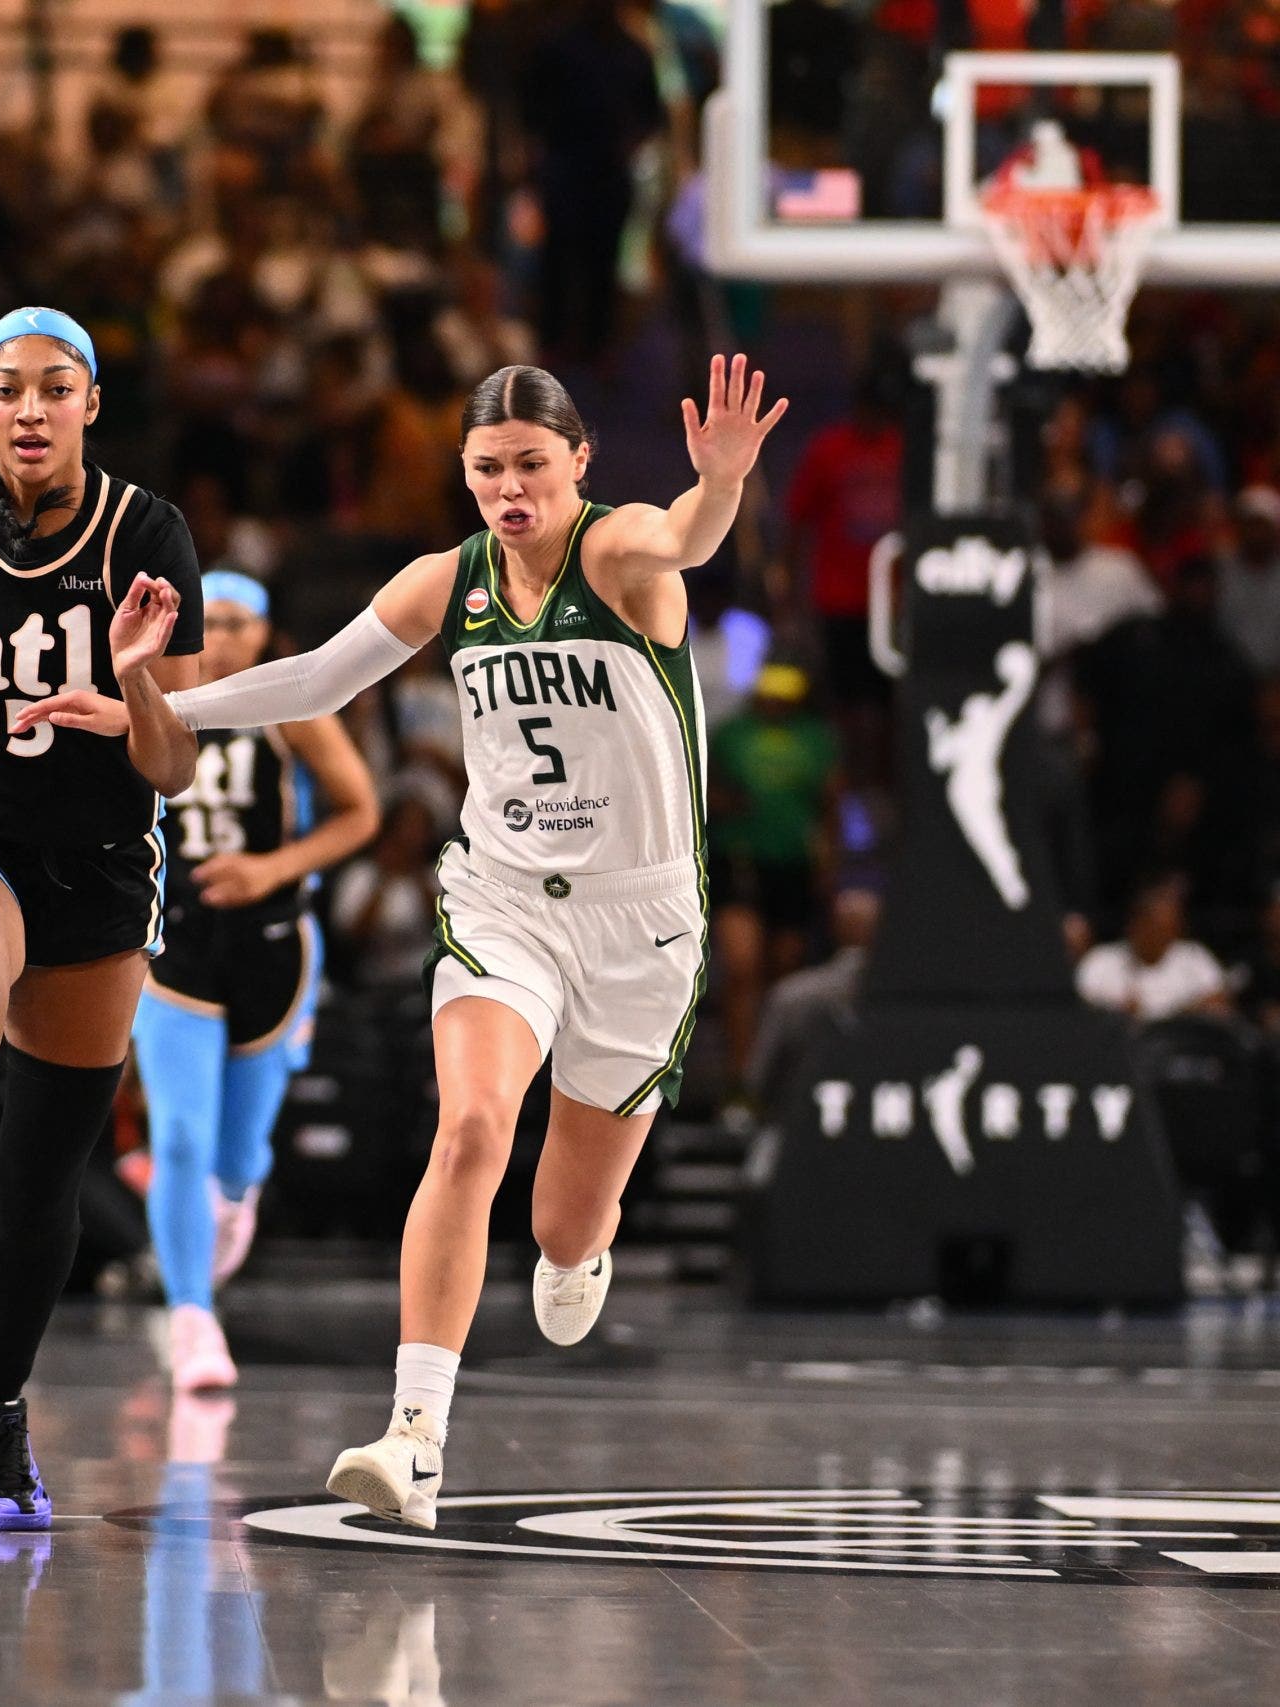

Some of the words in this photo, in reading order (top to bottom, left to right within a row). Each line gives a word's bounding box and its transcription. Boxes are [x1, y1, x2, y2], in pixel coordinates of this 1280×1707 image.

[58, 575, 105, 591] Albert
[554, 615, 588, 628] SYMETRA
[462, 651, 618, 720] STORM
[5, 698, 55, 758] 5
[518, 716, 567, 784] 5
[166, 735, 256, 807] tl
[535, 794, 610, 812] Providence
[538, 816, 594, 832] SWEDISH
[178, 807, 247, 859] 15
